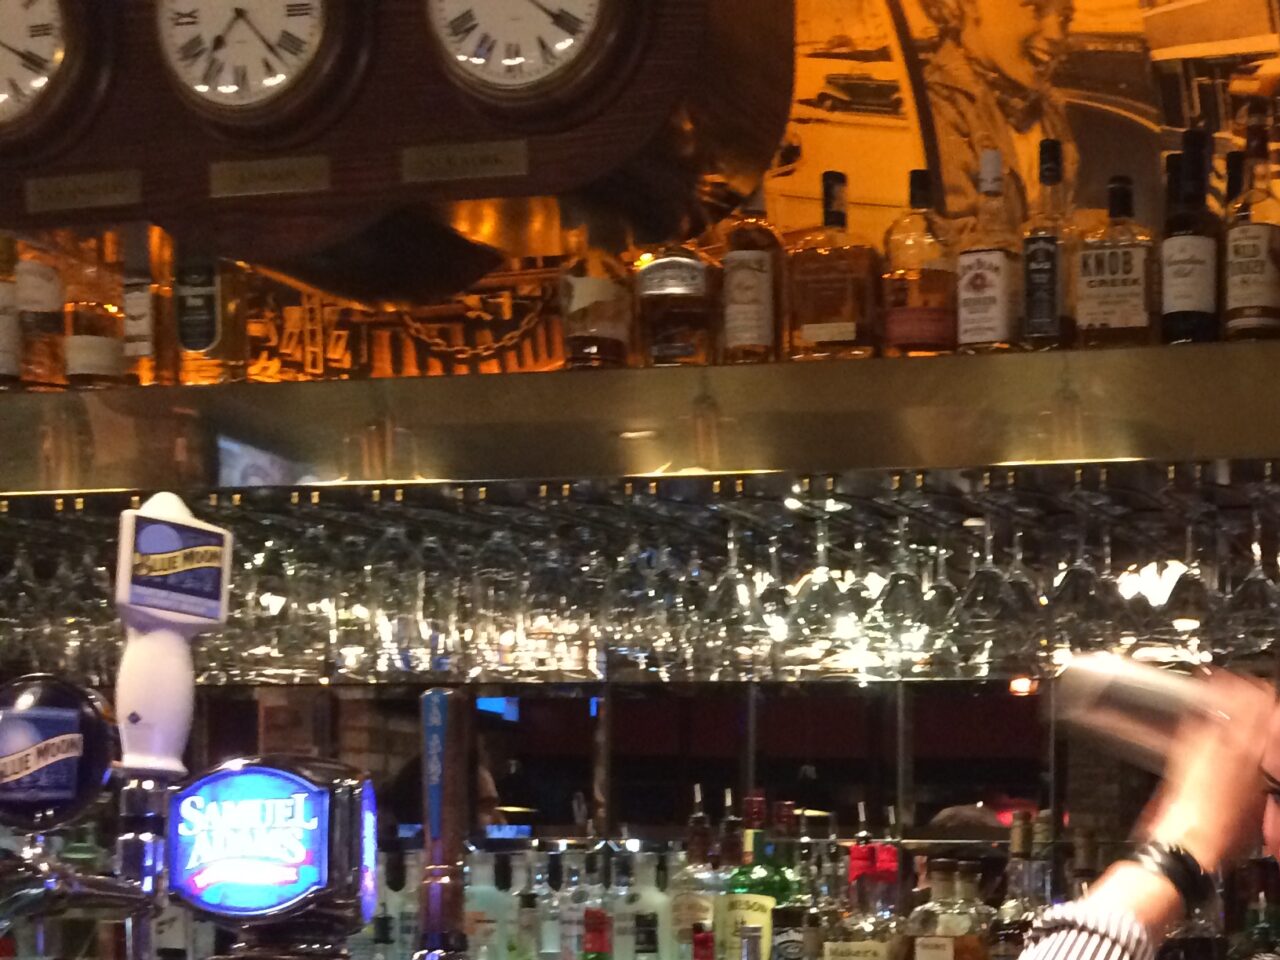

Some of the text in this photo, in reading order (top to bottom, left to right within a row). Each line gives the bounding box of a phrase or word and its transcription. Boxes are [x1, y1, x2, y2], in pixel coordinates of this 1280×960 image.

[1080, 250, 1134, 277] KNOB
[1086, 277, 1141, 289] CREEK
[178, 793, 319, 837] SAMUEL
[185, 826, 307, 870] ADAMS
